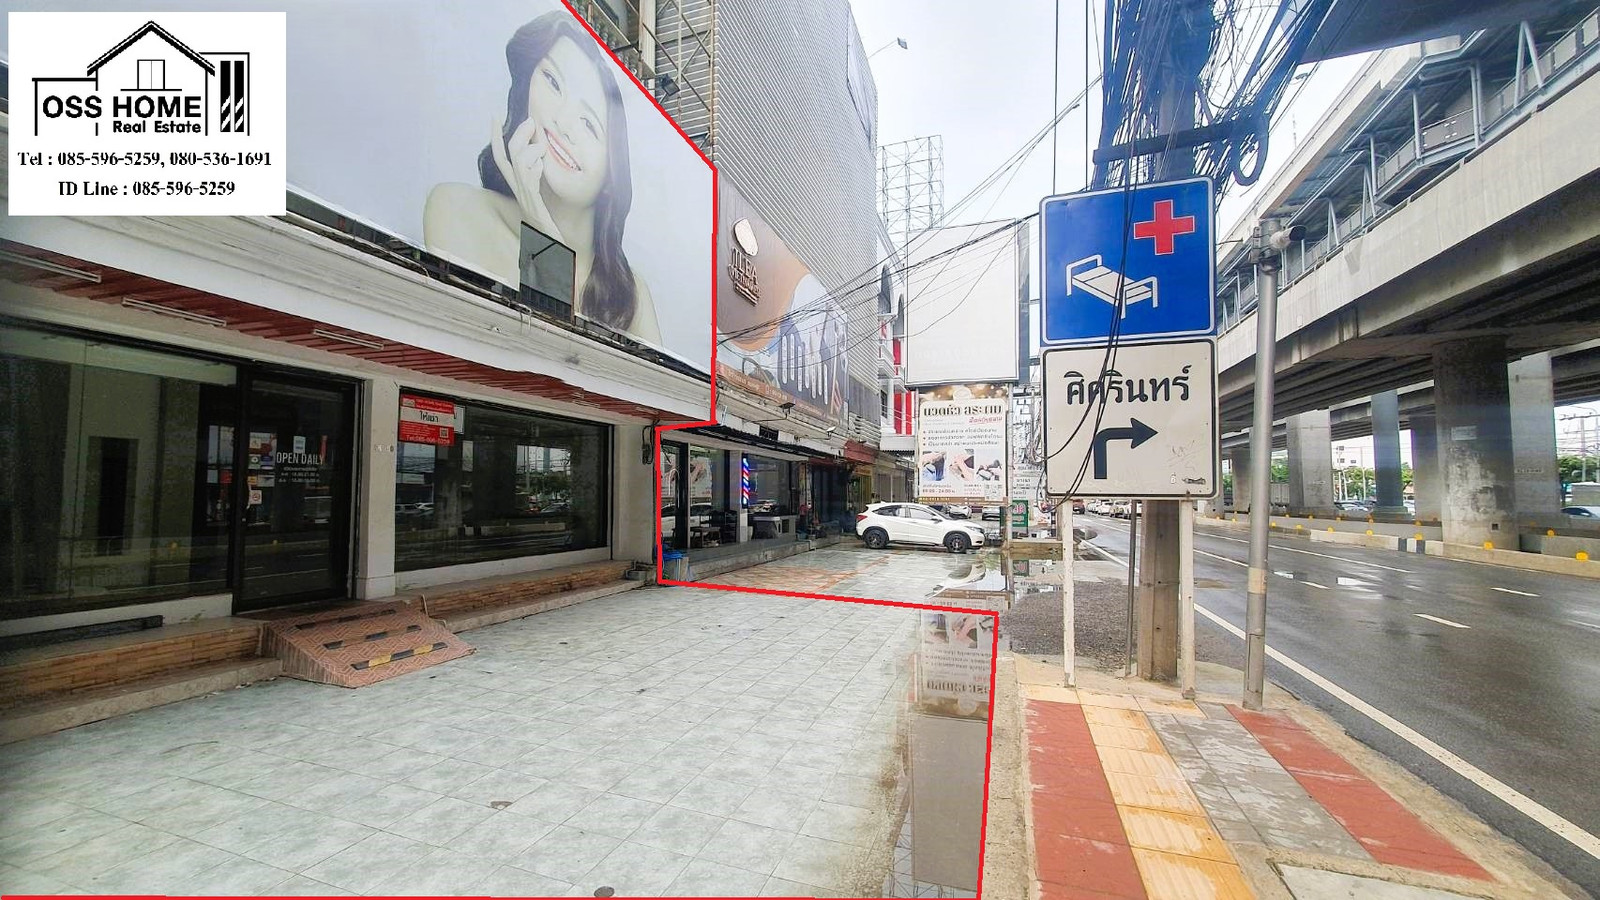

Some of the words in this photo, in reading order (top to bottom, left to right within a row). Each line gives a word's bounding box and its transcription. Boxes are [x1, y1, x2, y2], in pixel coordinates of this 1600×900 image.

[923, 404, 961, 416] นวดหัว
[276, 452, 299, 464] OPEN
[301, 453, 324, 465] DAILY
